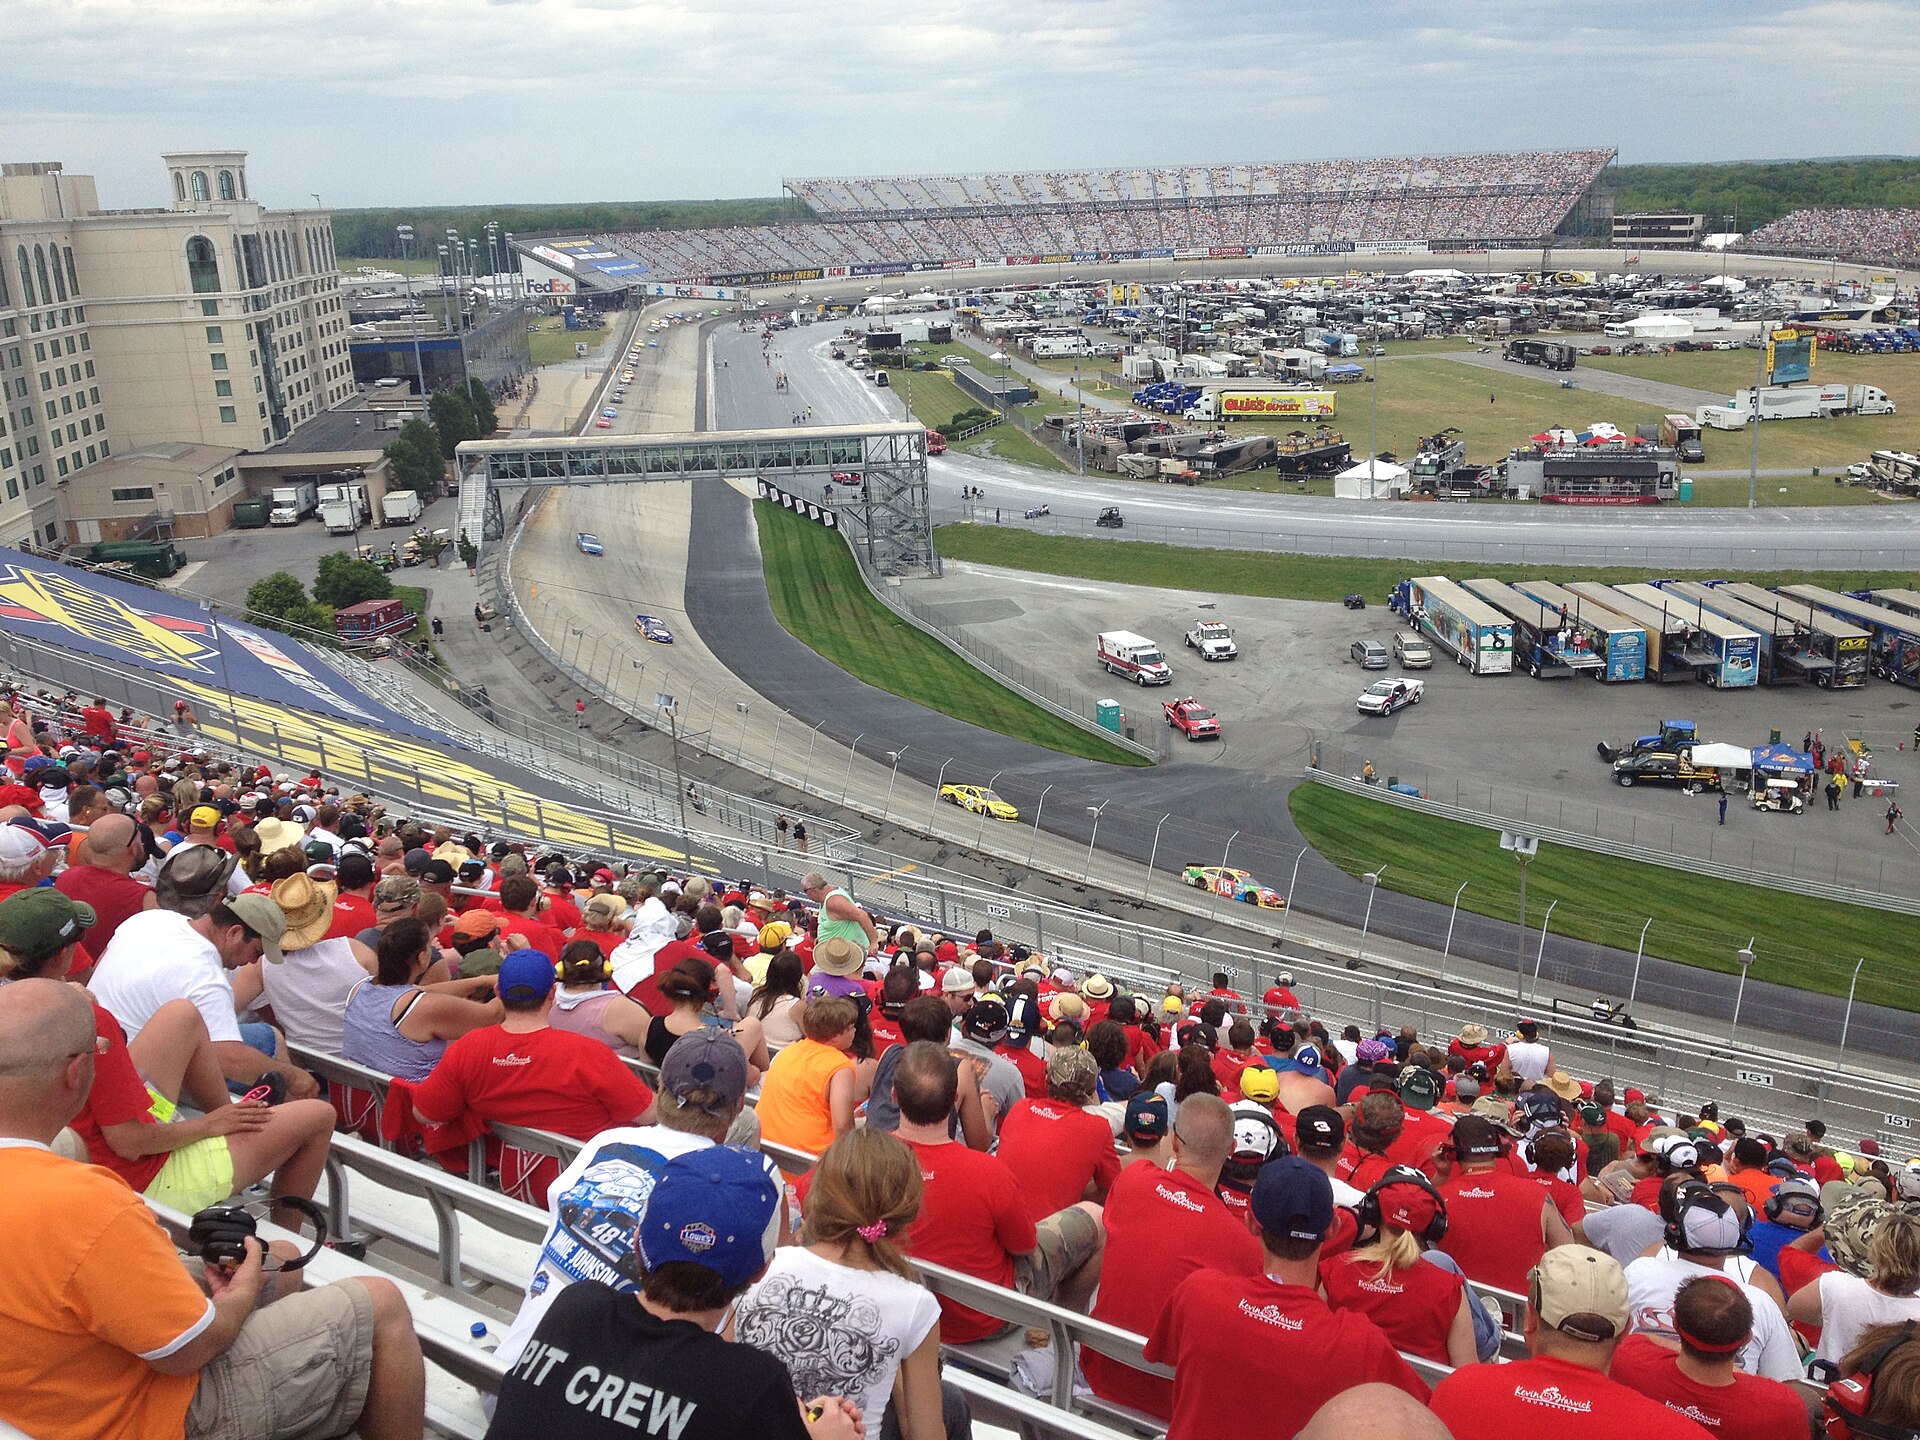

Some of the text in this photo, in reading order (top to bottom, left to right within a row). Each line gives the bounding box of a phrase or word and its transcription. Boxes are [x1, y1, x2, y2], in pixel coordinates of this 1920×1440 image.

[1257, 244, 1315, 255] AUTISM SPEAKS
[1320, 243, 1352, 252] AQUAFINA
[1043, 255, 1072, 263] SUNOCO
[770, 268, 820, 281] 5-hour ENERGY
[828, 266, 846, 277] ACME
[526, 278, 572, 294] FedEx
[675, 287, 703, 297] FedEx
[1225, 397, 1266, 411] OLLIE'S
[1266, 403, 1300, 411] OUTLET
[1220, 879, 1232, 894] 18
[988, 906, 1008, 917] 152
[1222, 965, 1238, 976] 153
[1302, 1056, 1314, 1065] 48
[1739, 1071, 1771, 1084] 151
[1313, 1121, 1331, 1132] 3
[1887, 1115, 1911, 1127] 151
[1156, 1183, 1173, 1198] Kevin
[589, 1222, 620, 1245] 48
[685, 1231, 712, 1243] LOWE'S
[569, 1248, 621, 1287] JOHNSON
[1358, 1279, 1375, 1289] Kevin
[1238, 1298, 1304, 1330] Kevin Harvick
[513, 1340, 569, 1387] PIT
[565, 1365, 698, 1440] CREW
[1515, 1385, 1592, 1412] Kevin Harvick
[1521, 1397, 1578, 1414] FOUNDATION
[1665, 1399, 1722, 1426] Kevin Harvick
